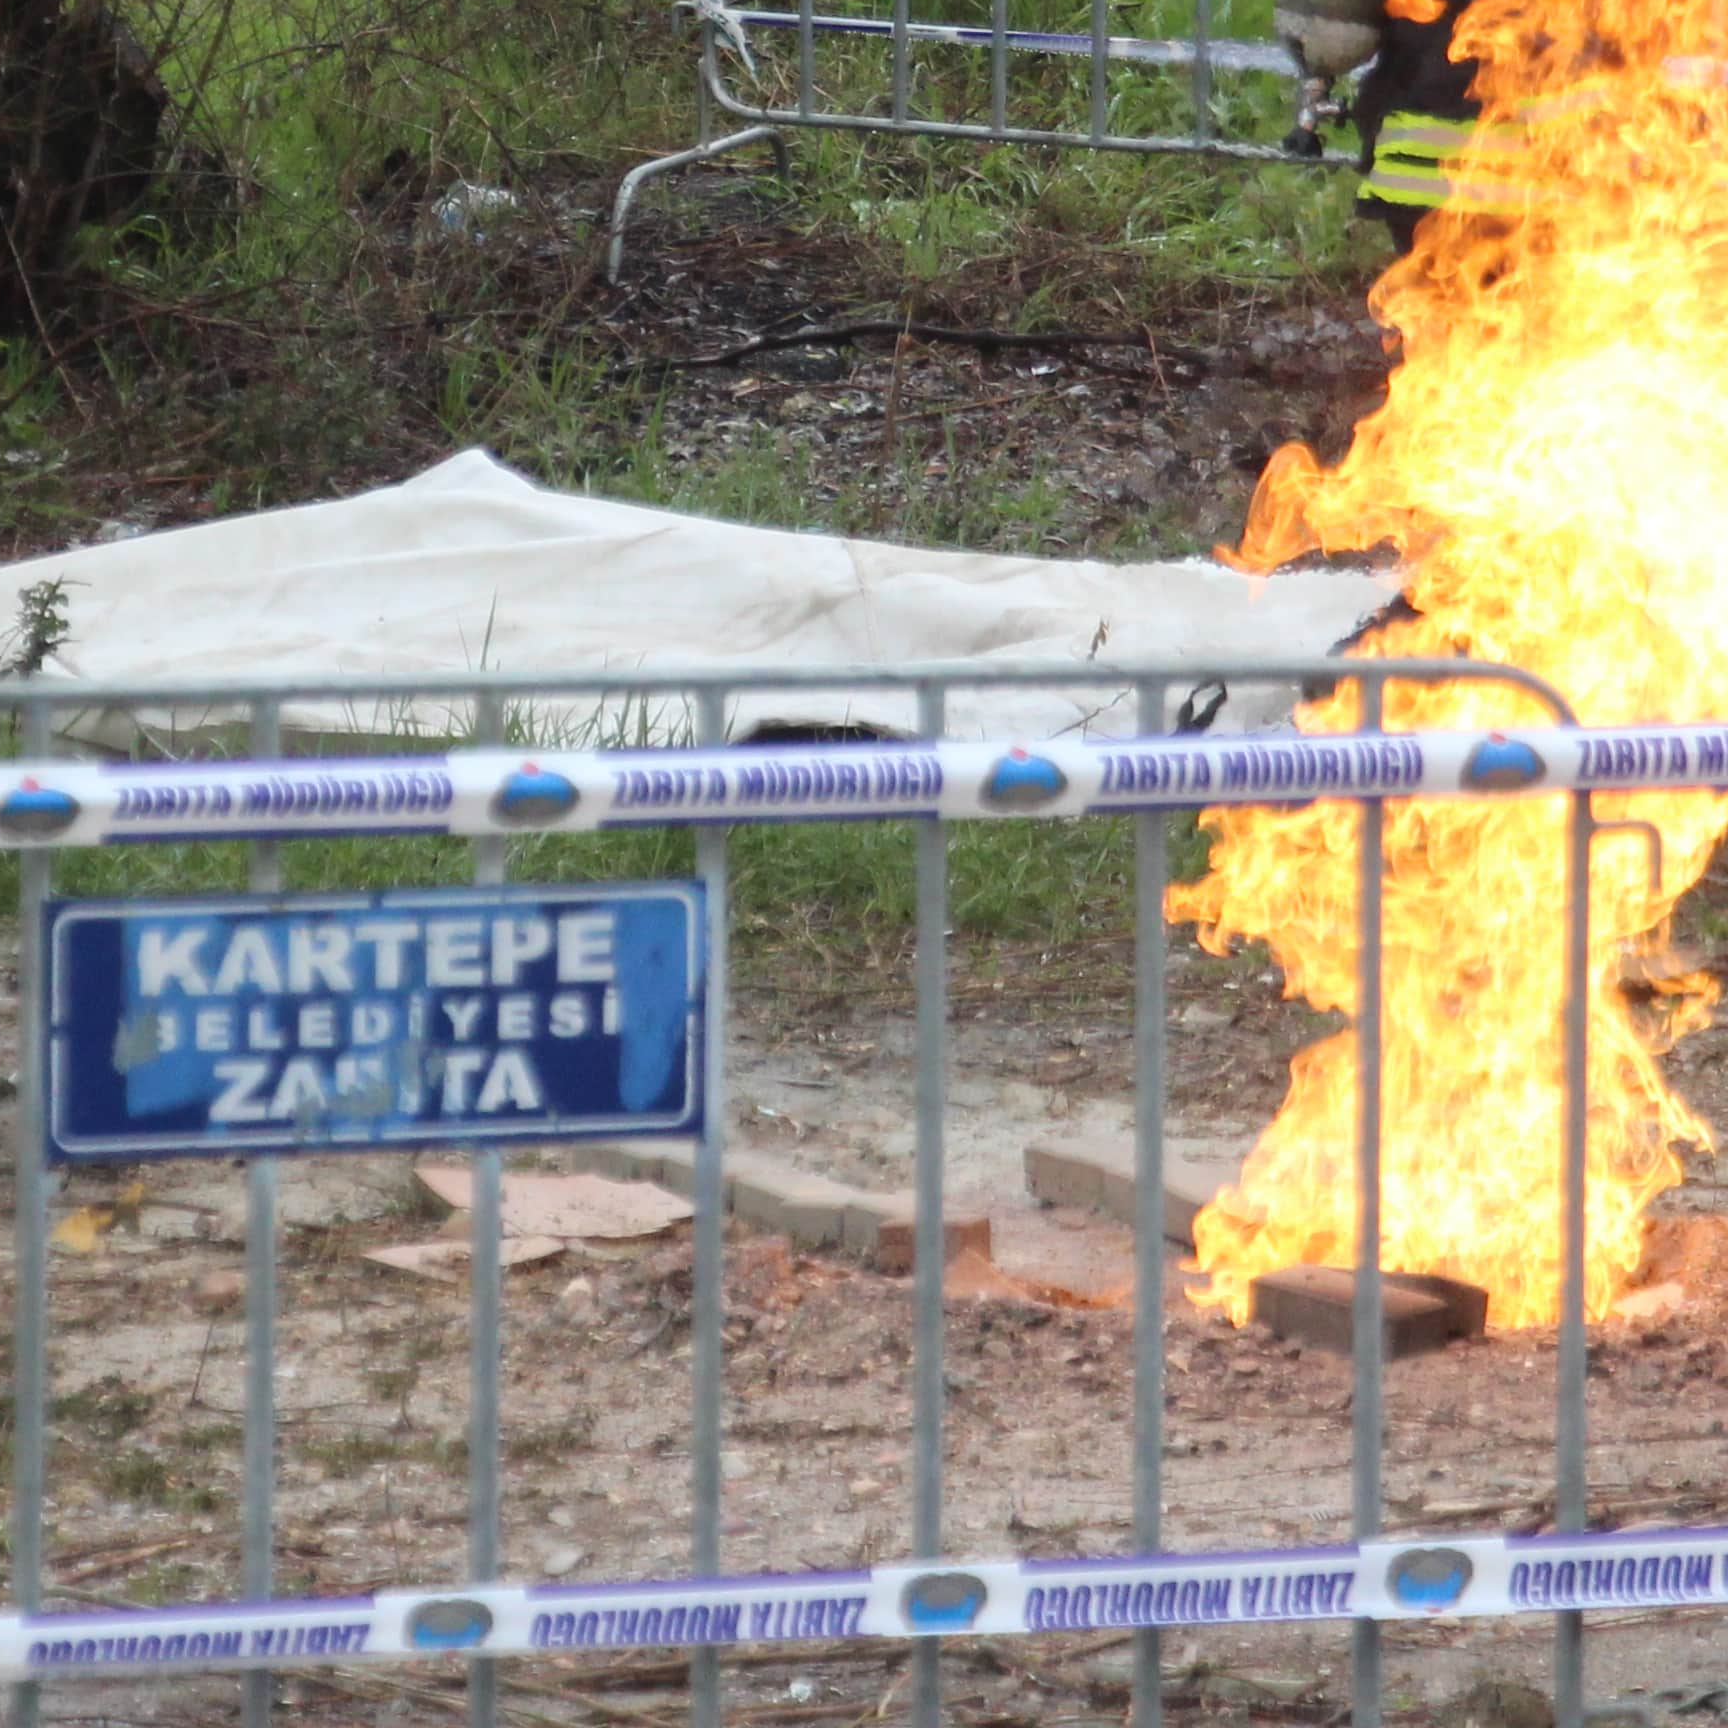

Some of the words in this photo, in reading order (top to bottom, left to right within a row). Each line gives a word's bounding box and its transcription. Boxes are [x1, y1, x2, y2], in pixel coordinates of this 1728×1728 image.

[1097, 752, 1212, 795] ZABITA
[1575, 735, 1689, 780] ZABITA
[609, 768, 729, 809] ZABITA
[136, 912, 619, 997] KARTEPE
[1240, 1571, 1355, 1618] ZABITA
